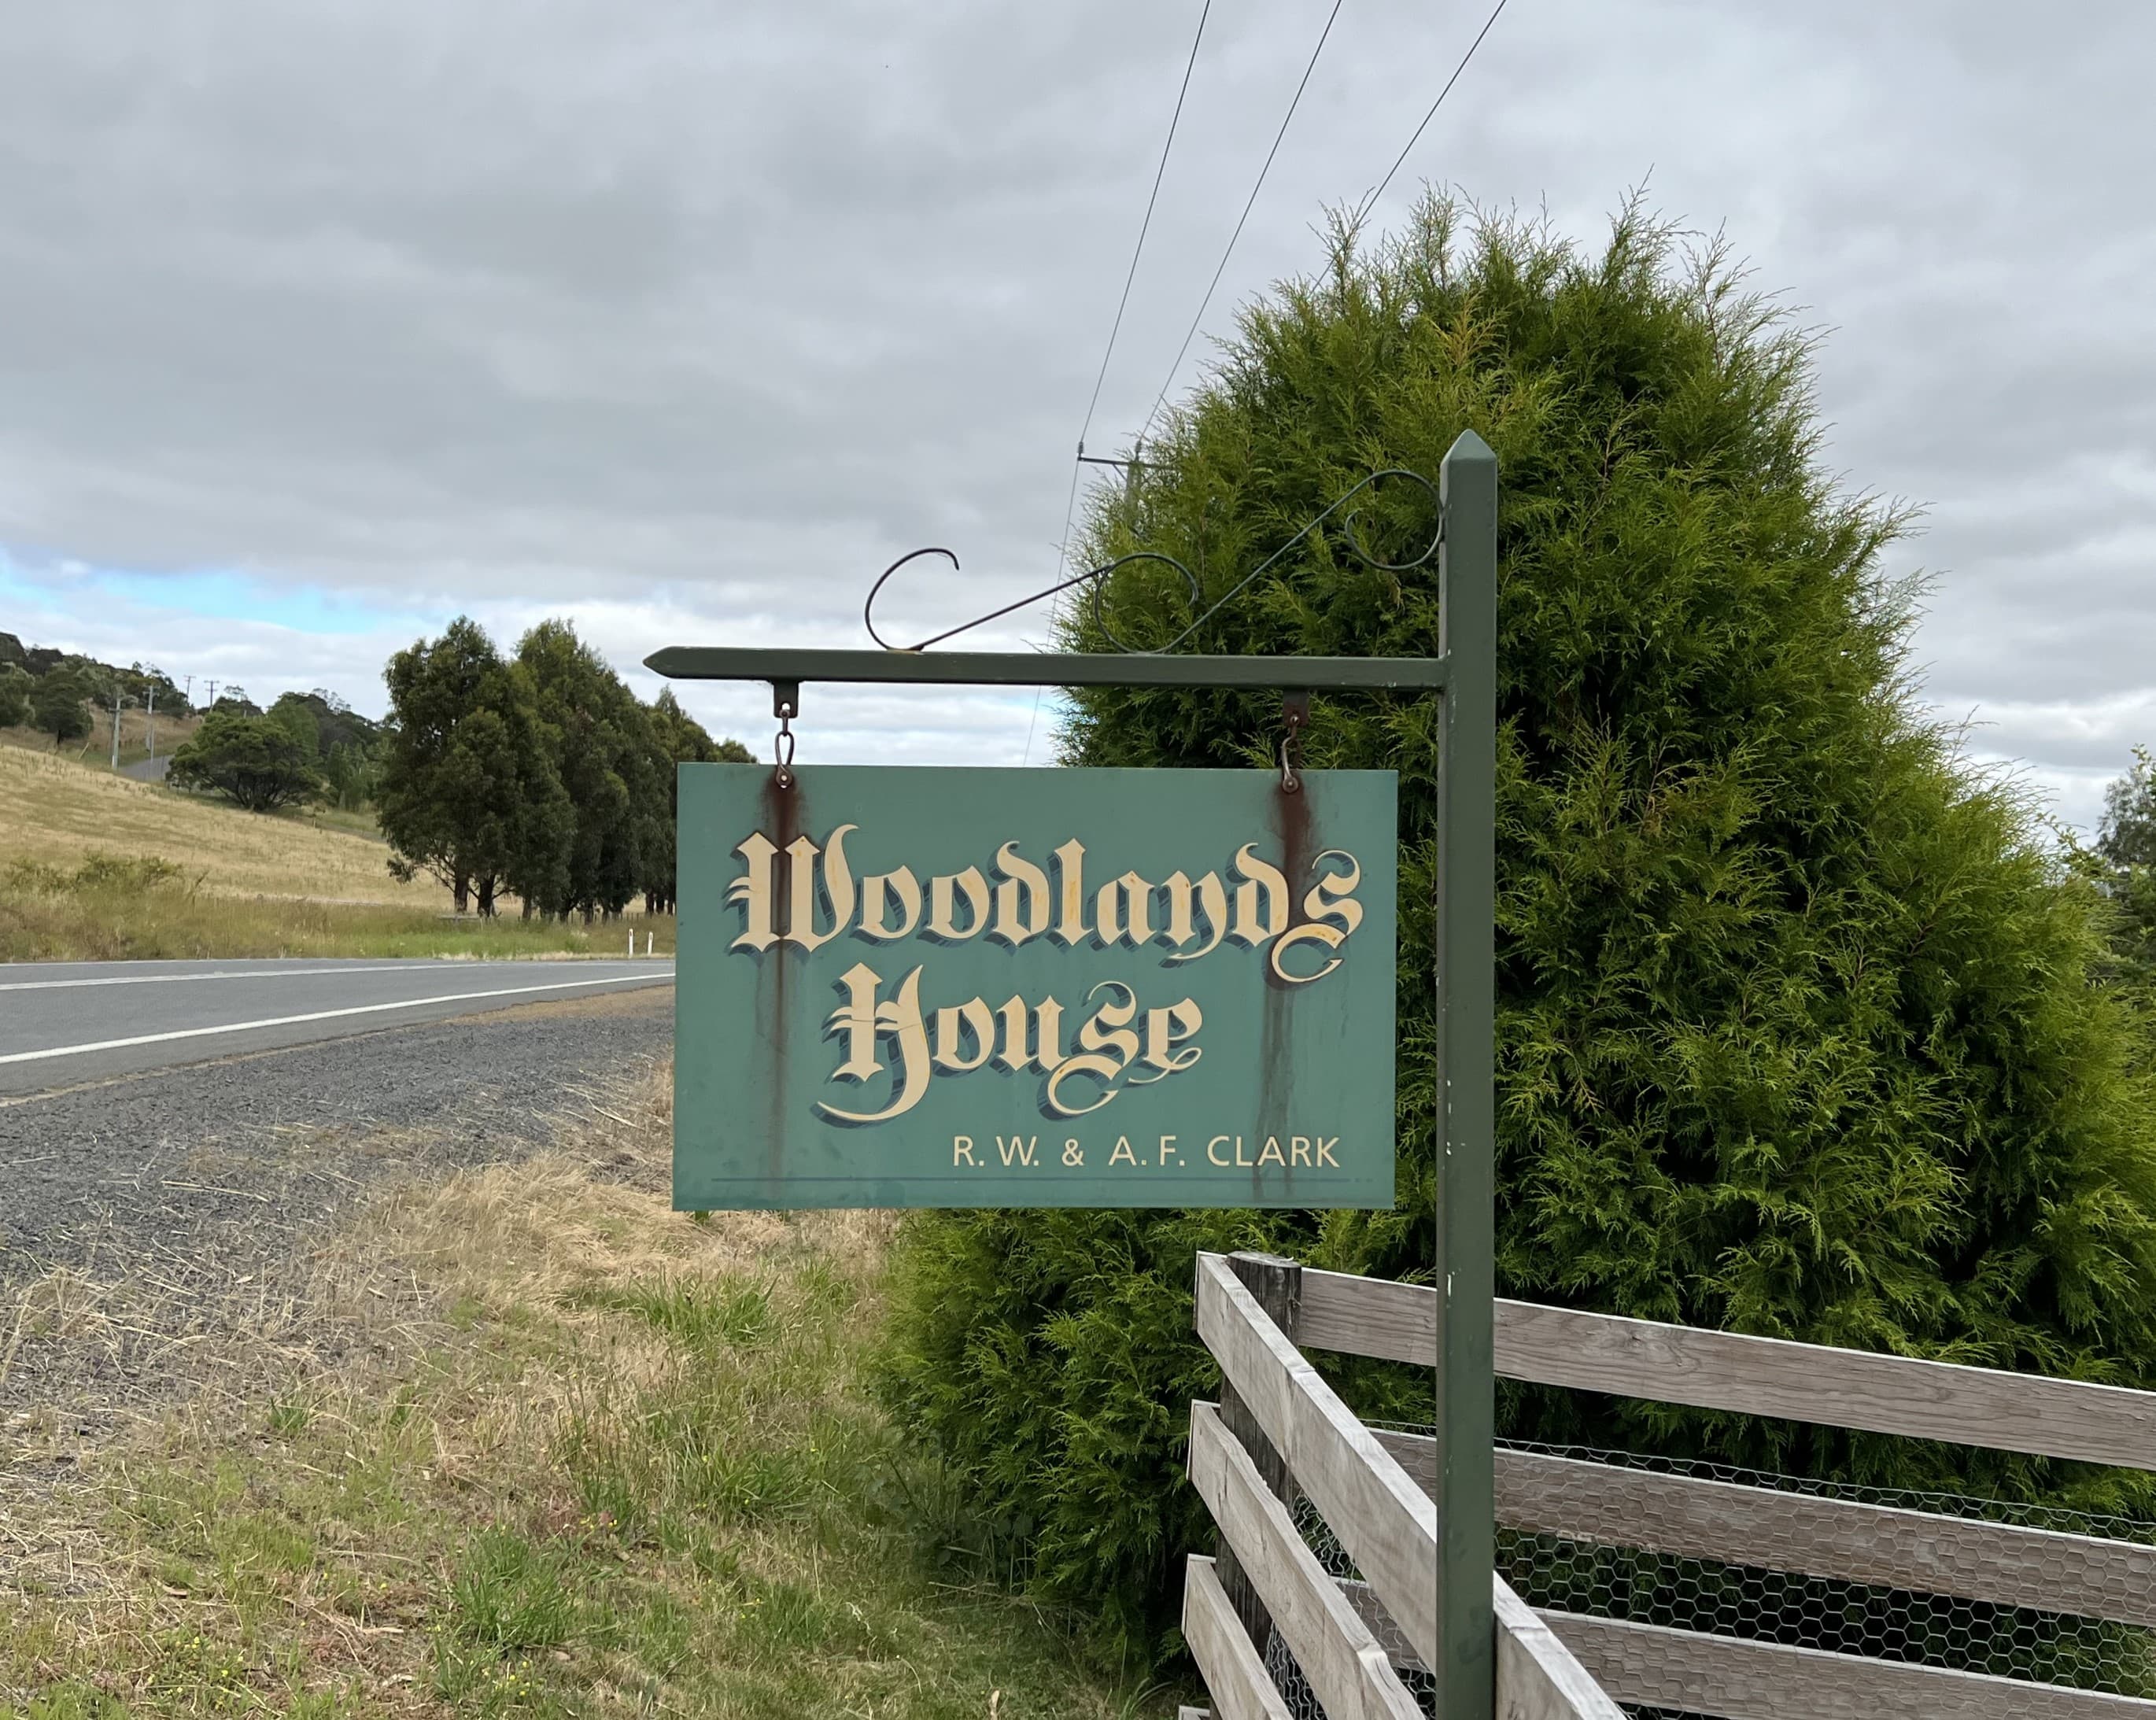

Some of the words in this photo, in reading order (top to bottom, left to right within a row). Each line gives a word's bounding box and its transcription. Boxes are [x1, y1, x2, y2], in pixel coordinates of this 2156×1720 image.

[727, 823, 1364, 984] Woodlands
[816, 962, 1204, 1123] House
[1061, 1138, 1085, 1168] &
[1206, 1135, 1341, 1168] CLARK
